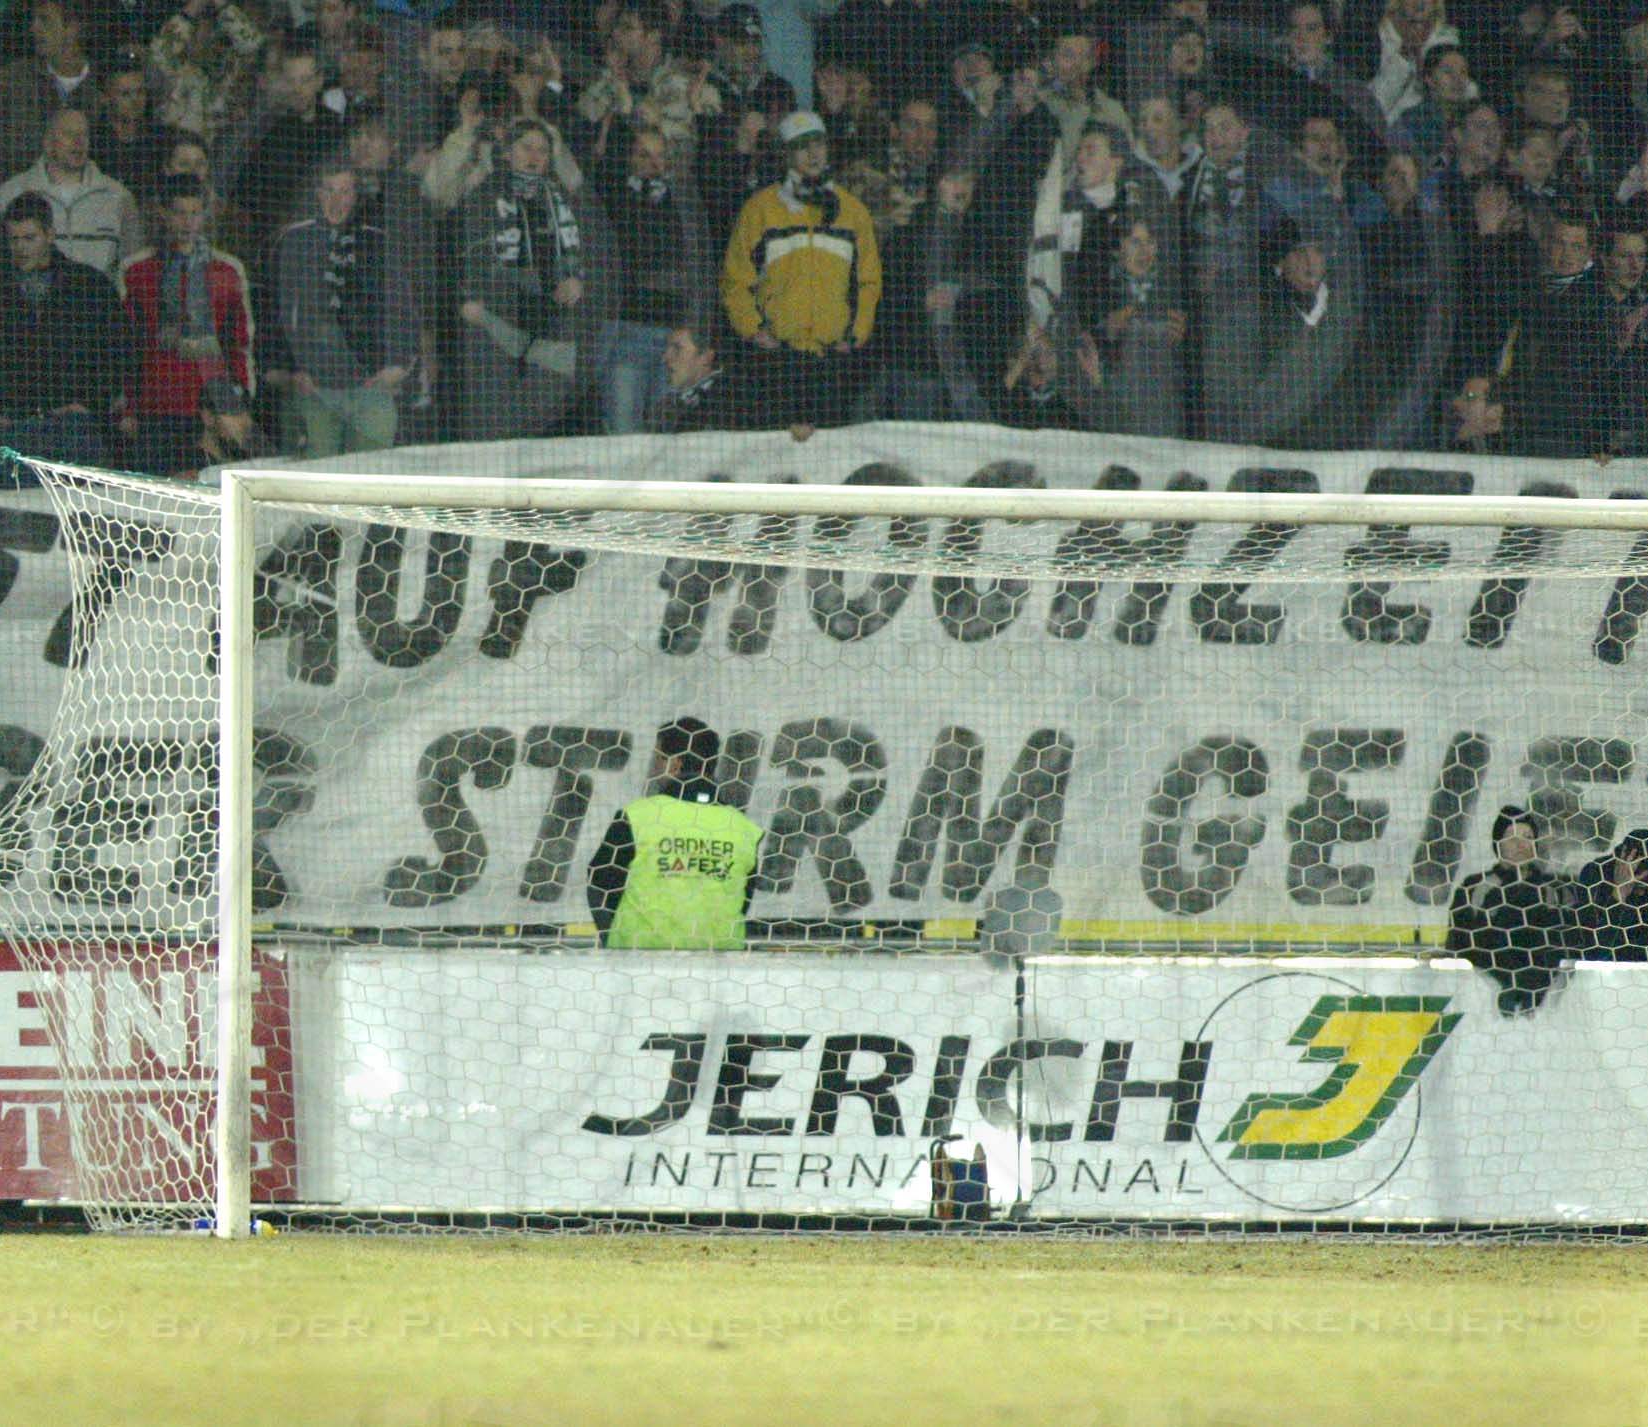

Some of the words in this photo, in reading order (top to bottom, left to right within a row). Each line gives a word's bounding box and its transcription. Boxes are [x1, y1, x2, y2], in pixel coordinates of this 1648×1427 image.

[208, 523, 591, 686] AUF
[658, 837, 734, 857] ORDNER
[582, 1032, 1213, 1143] JERICH
[625, 1152, 1205, 1195] INTERNAONAL
